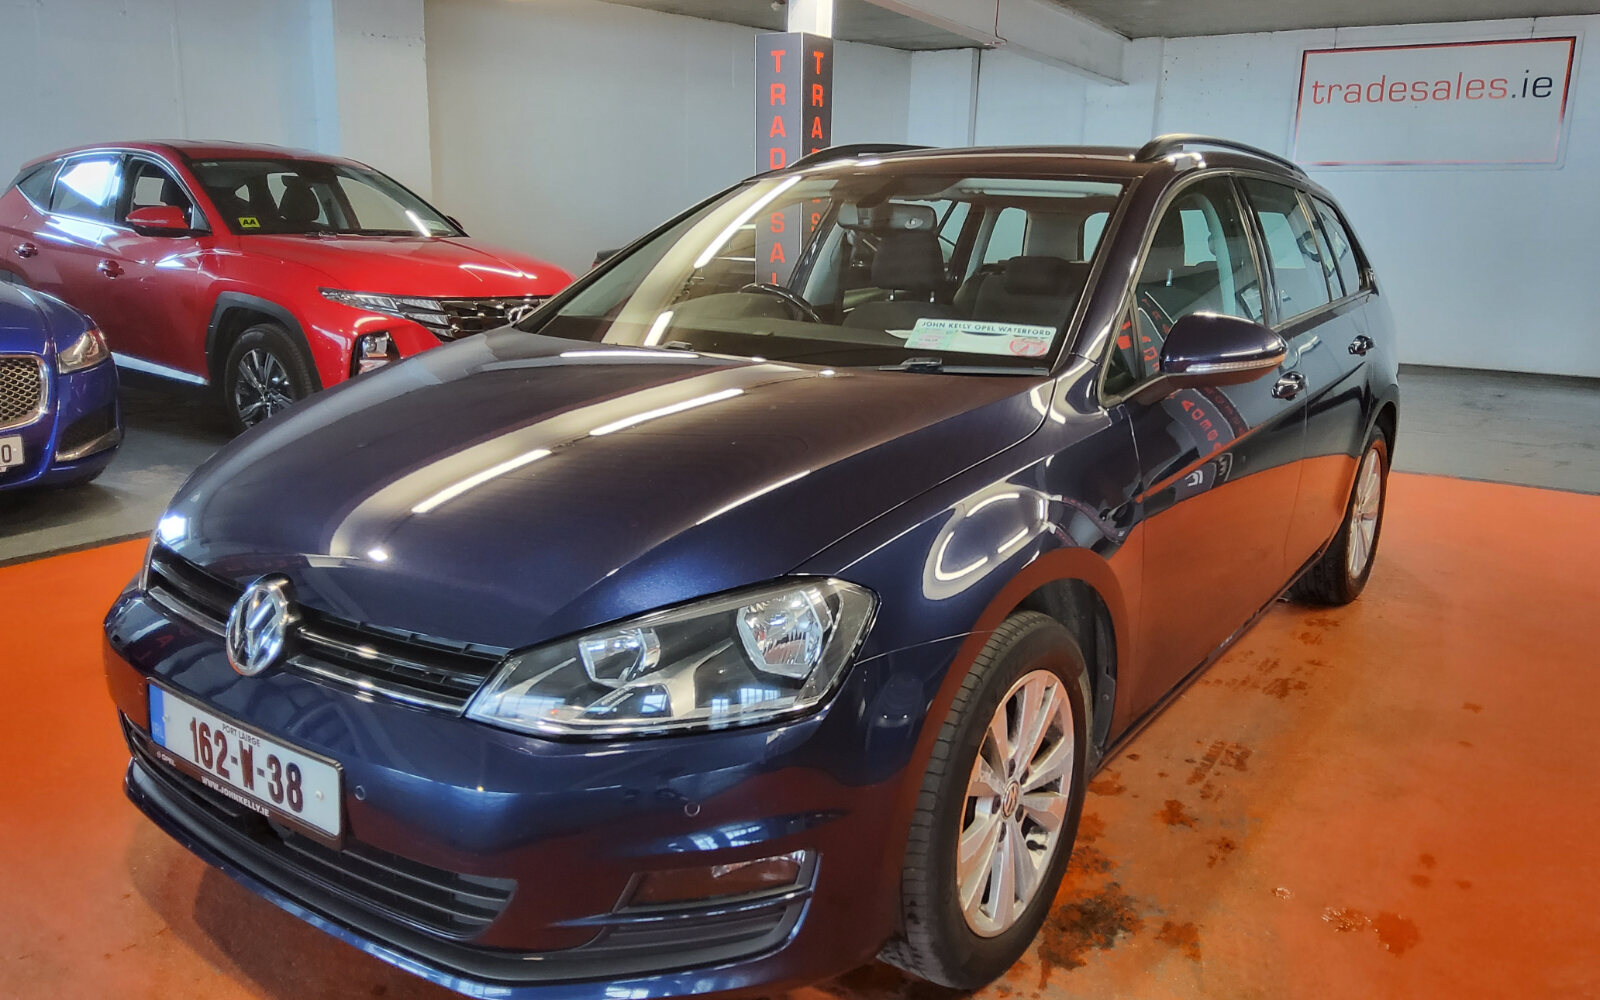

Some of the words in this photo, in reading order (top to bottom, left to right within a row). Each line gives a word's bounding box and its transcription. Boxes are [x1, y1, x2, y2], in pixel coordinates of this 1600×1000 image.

[1312, 69, 1553, 105] tradesales.ie
[922, 321, 946, 329] JOHN
[948, 323, 972, 331] KELLY
[974, 325, 996, 333] OPEL
[998, 327, 1051, 336] WATERFORD
[222, 723, 238, 737] PORT
[190, 717, 304, 814] 162-W-38
